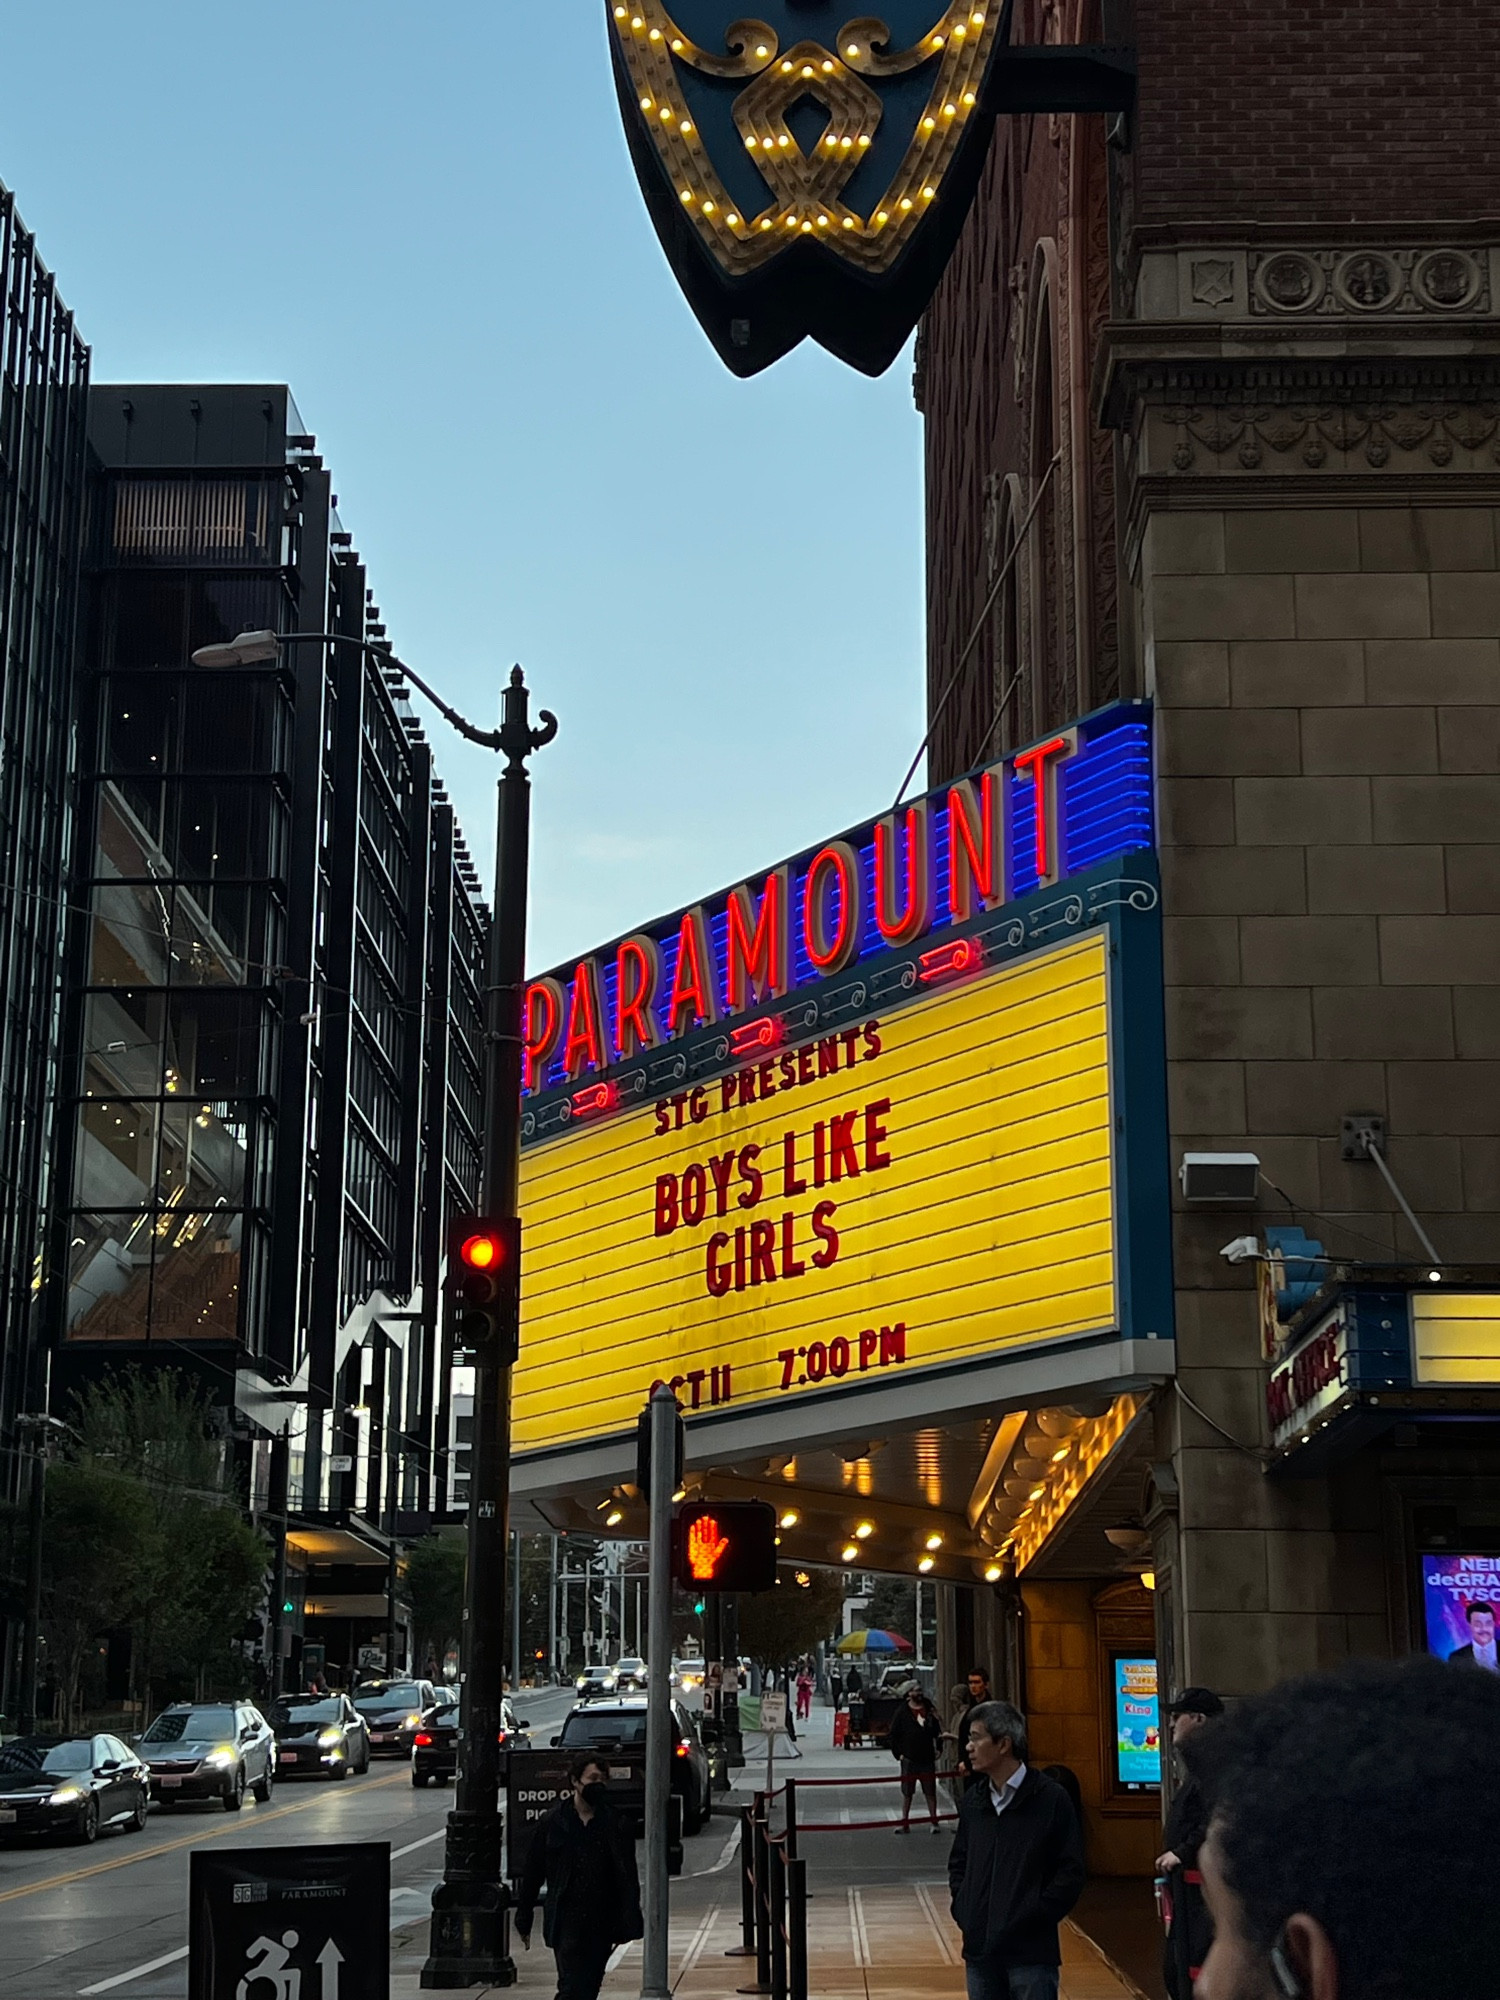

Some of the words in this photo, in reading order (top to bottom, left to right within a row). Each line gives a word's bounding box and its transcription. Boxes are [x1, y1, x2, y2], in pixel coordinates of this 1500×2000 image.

[524, 728, 1076, 1096] PARAMOUNT
[655, 1086, 708, 1136] STG
[721, 1020, 882, 1113] PRESENTS
[655, 1143, 763, 1237] BOYS
[784, 1097, 891, 1198] LIKE
[706, 1200, 839, 1297] GIRLS
[711, 1363, 731, 1405] 11
[778, 1336, 850, 1390] 7:00
[859, 1322, 906, 1372] PM
[518, 1790, 557, 1801] DROP
[282, 1888, 347, 1899] PARAMOUNT
